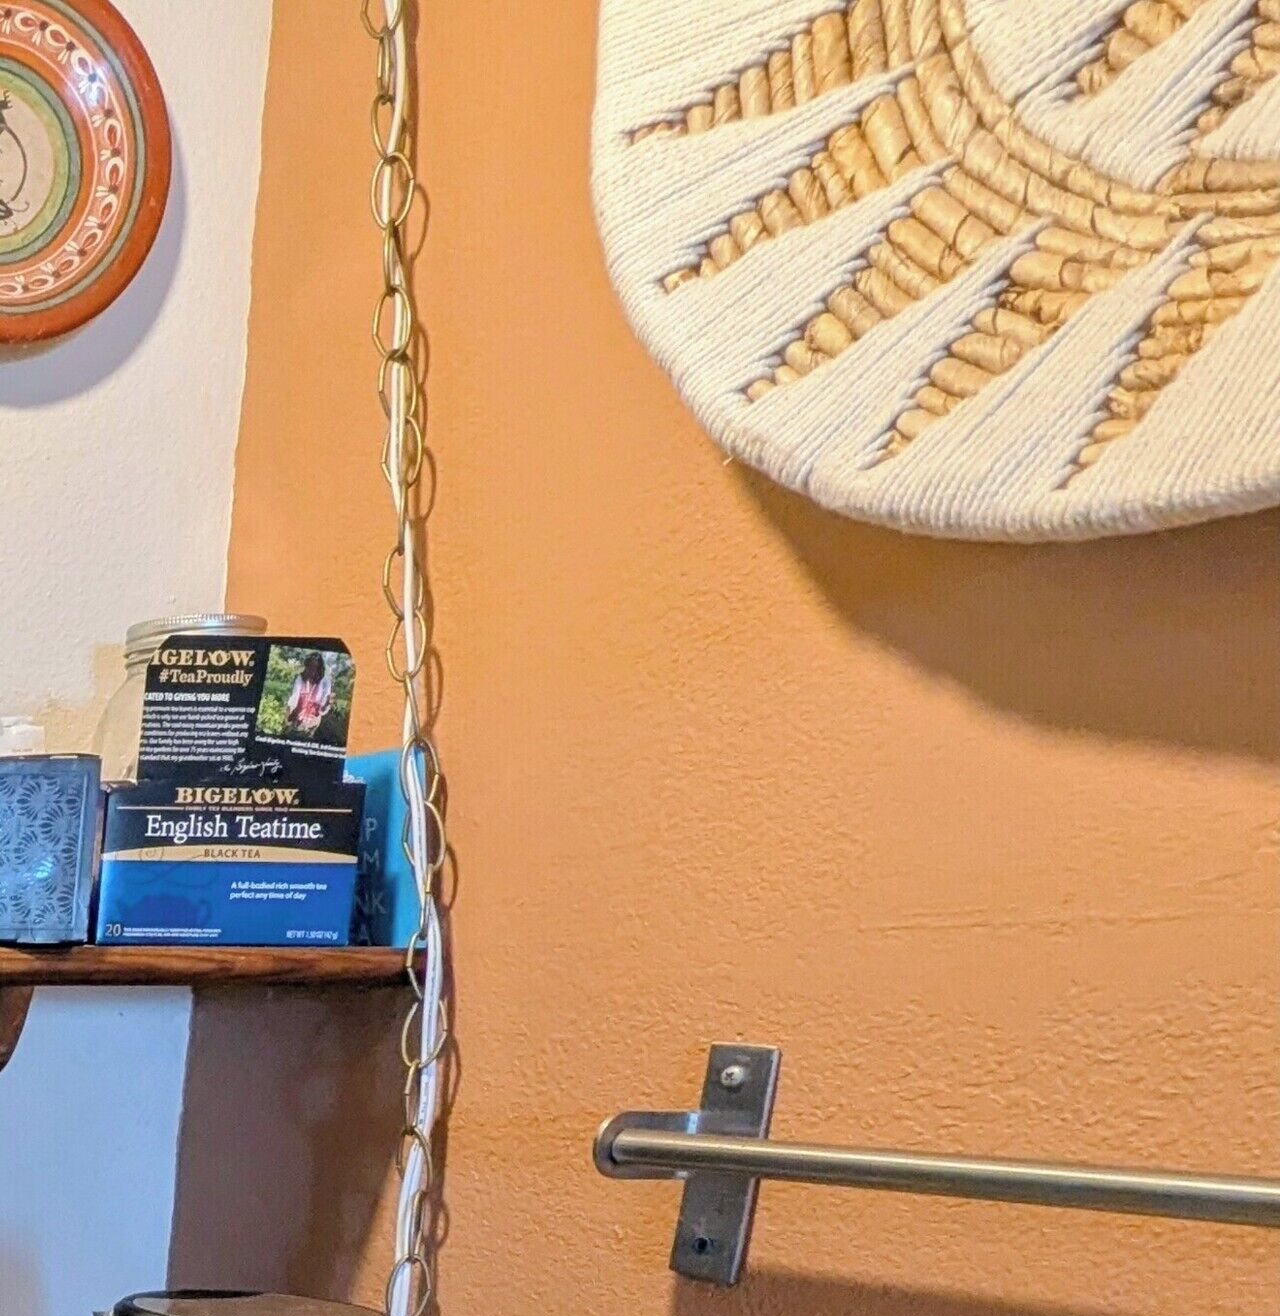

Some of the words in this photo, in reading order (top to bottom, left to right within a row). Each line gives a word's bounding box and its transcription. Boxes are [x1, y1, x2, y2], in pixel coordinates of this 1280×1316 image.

[159, 669, 254, 687] #TeaProudly
[175, 787, 299, 805] BIGELOW
[144, 814, 229, 844] English
[235, 815, 322, 839] Teatime
[204, 849, 237, 858] BLACK
[241, 849, 261, 858] TEA
[231, 881, 237, 890] A
[229, 890, 255, 901] perfect
[105, 923, 121, 937] 20
